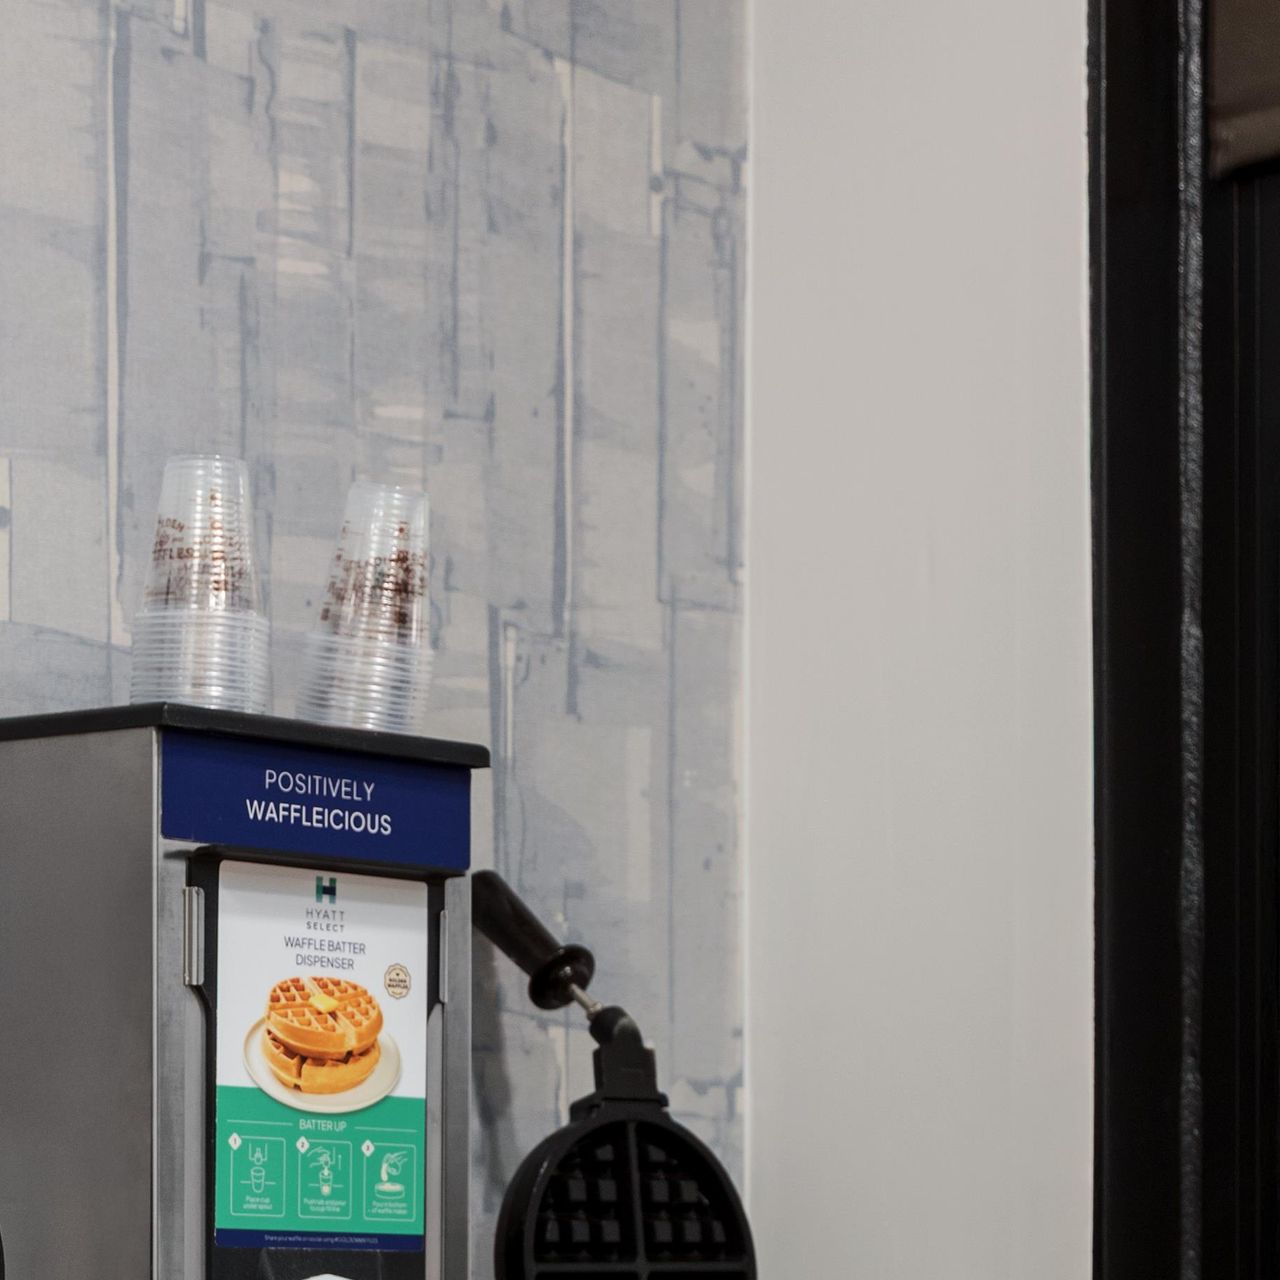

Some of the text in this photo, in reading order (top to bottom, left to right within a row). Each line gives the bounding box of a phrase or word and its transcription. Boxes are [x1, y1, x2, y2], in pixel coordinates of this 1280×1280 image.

[265, 769, 375, 801] POSITIVELY
[246, 799, 392, 836] WAFFLEICIOUS
[305, 908, 345, 921] HYATT
[306, 921, 345, 933] SELECT
[284, 936, 366, 955] WAFFLE BATTER
[295, 953, 354, 970] DISPENSER
[299, 1118, 347, 1132] BATTER UP
